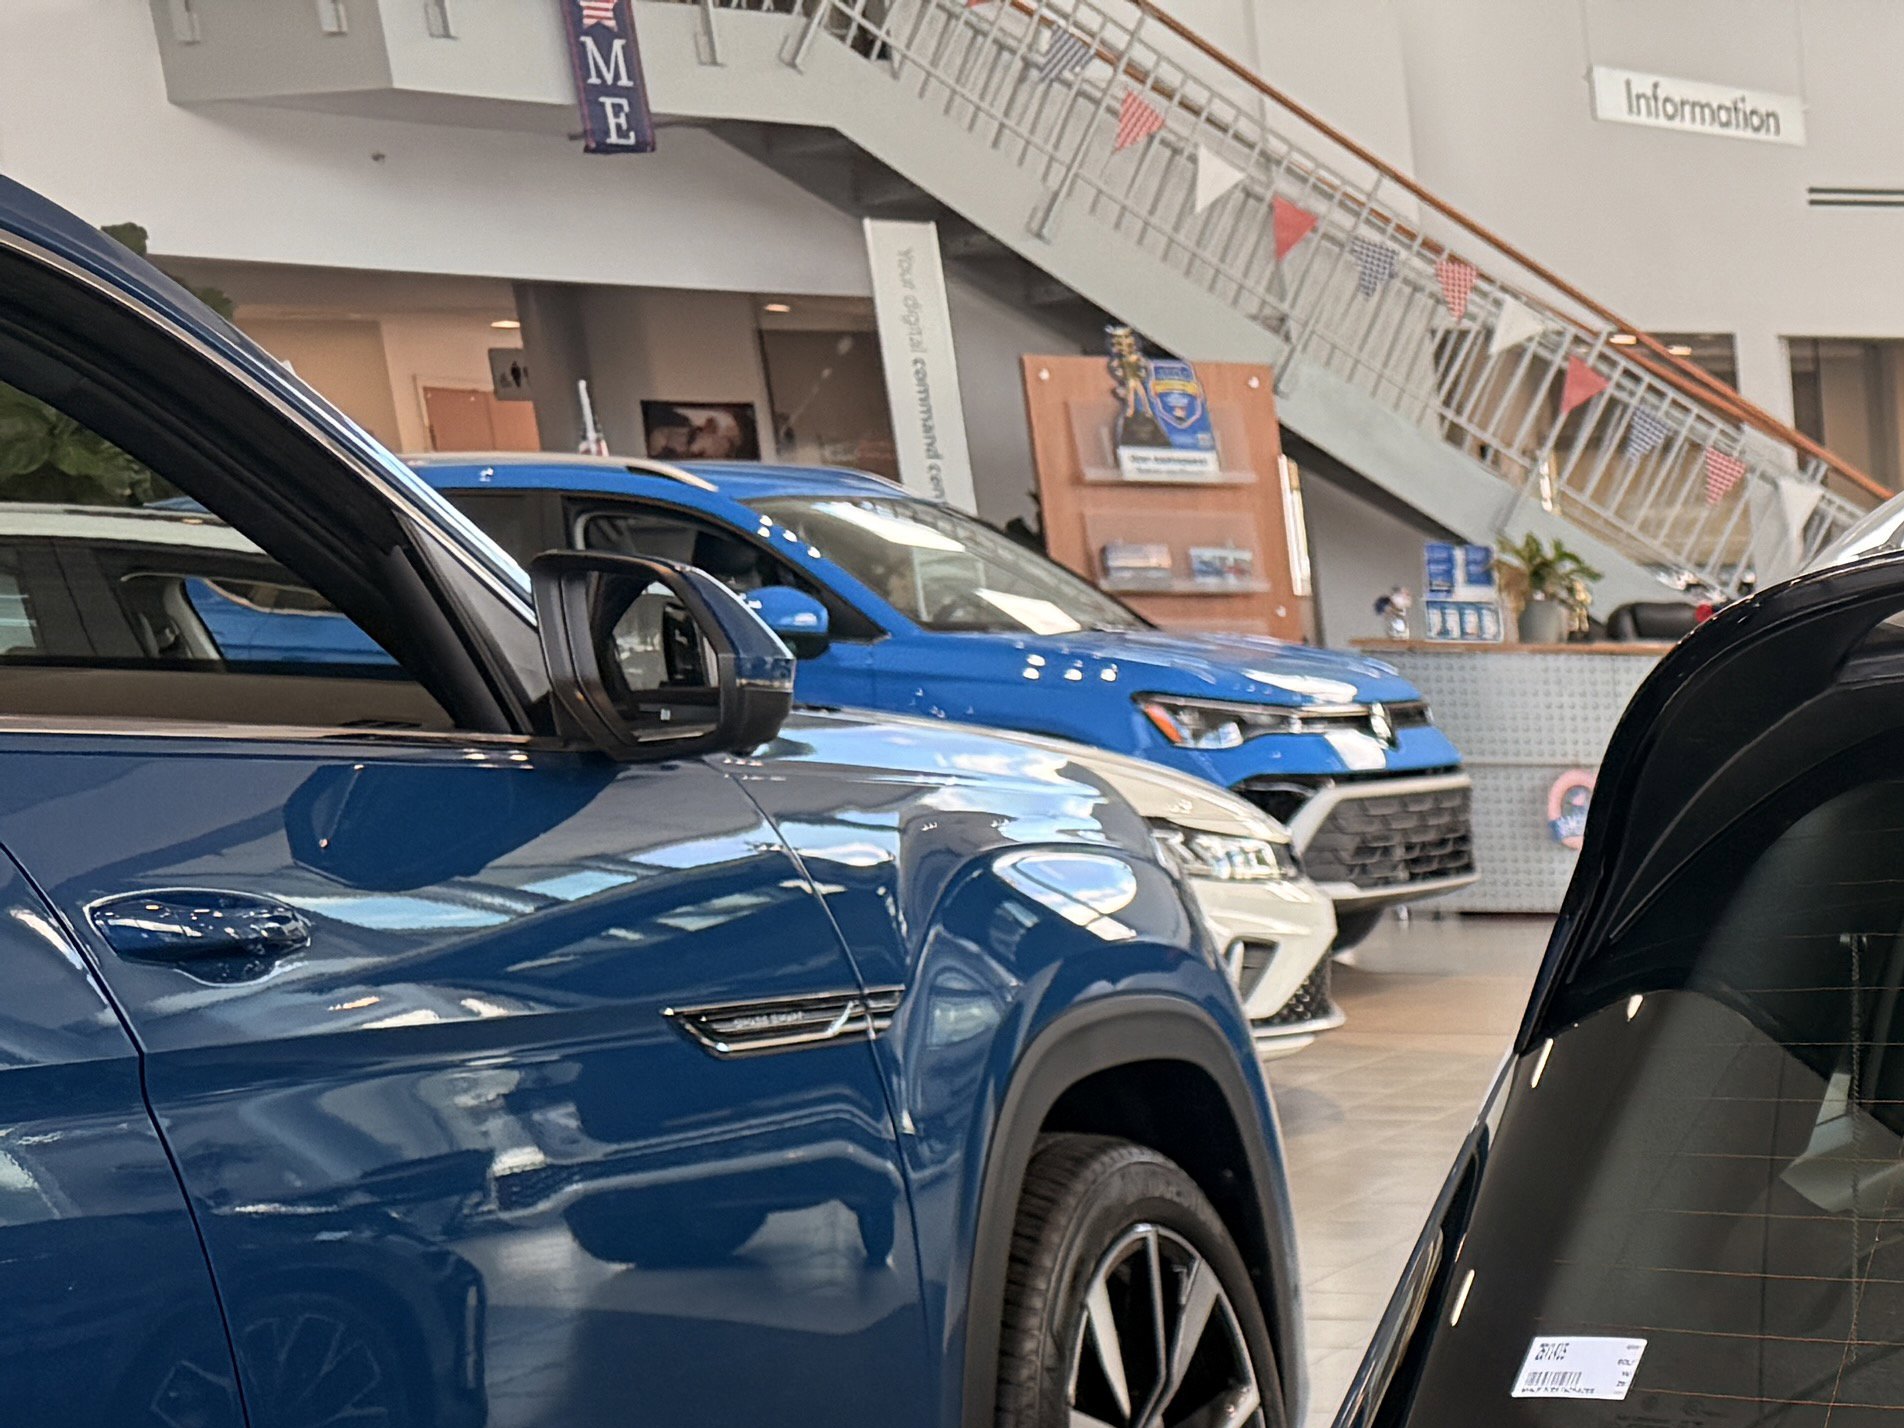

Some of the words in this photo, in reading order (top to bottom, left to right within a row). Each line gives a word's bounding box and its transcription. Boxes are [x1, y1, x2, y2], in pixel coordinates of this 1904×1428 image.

[1624, 77, 1781, 137] Information
[901, 295, 928, 354] digital
[912, 358, 943, 460] command
[927, 463, 946, 499] cen
